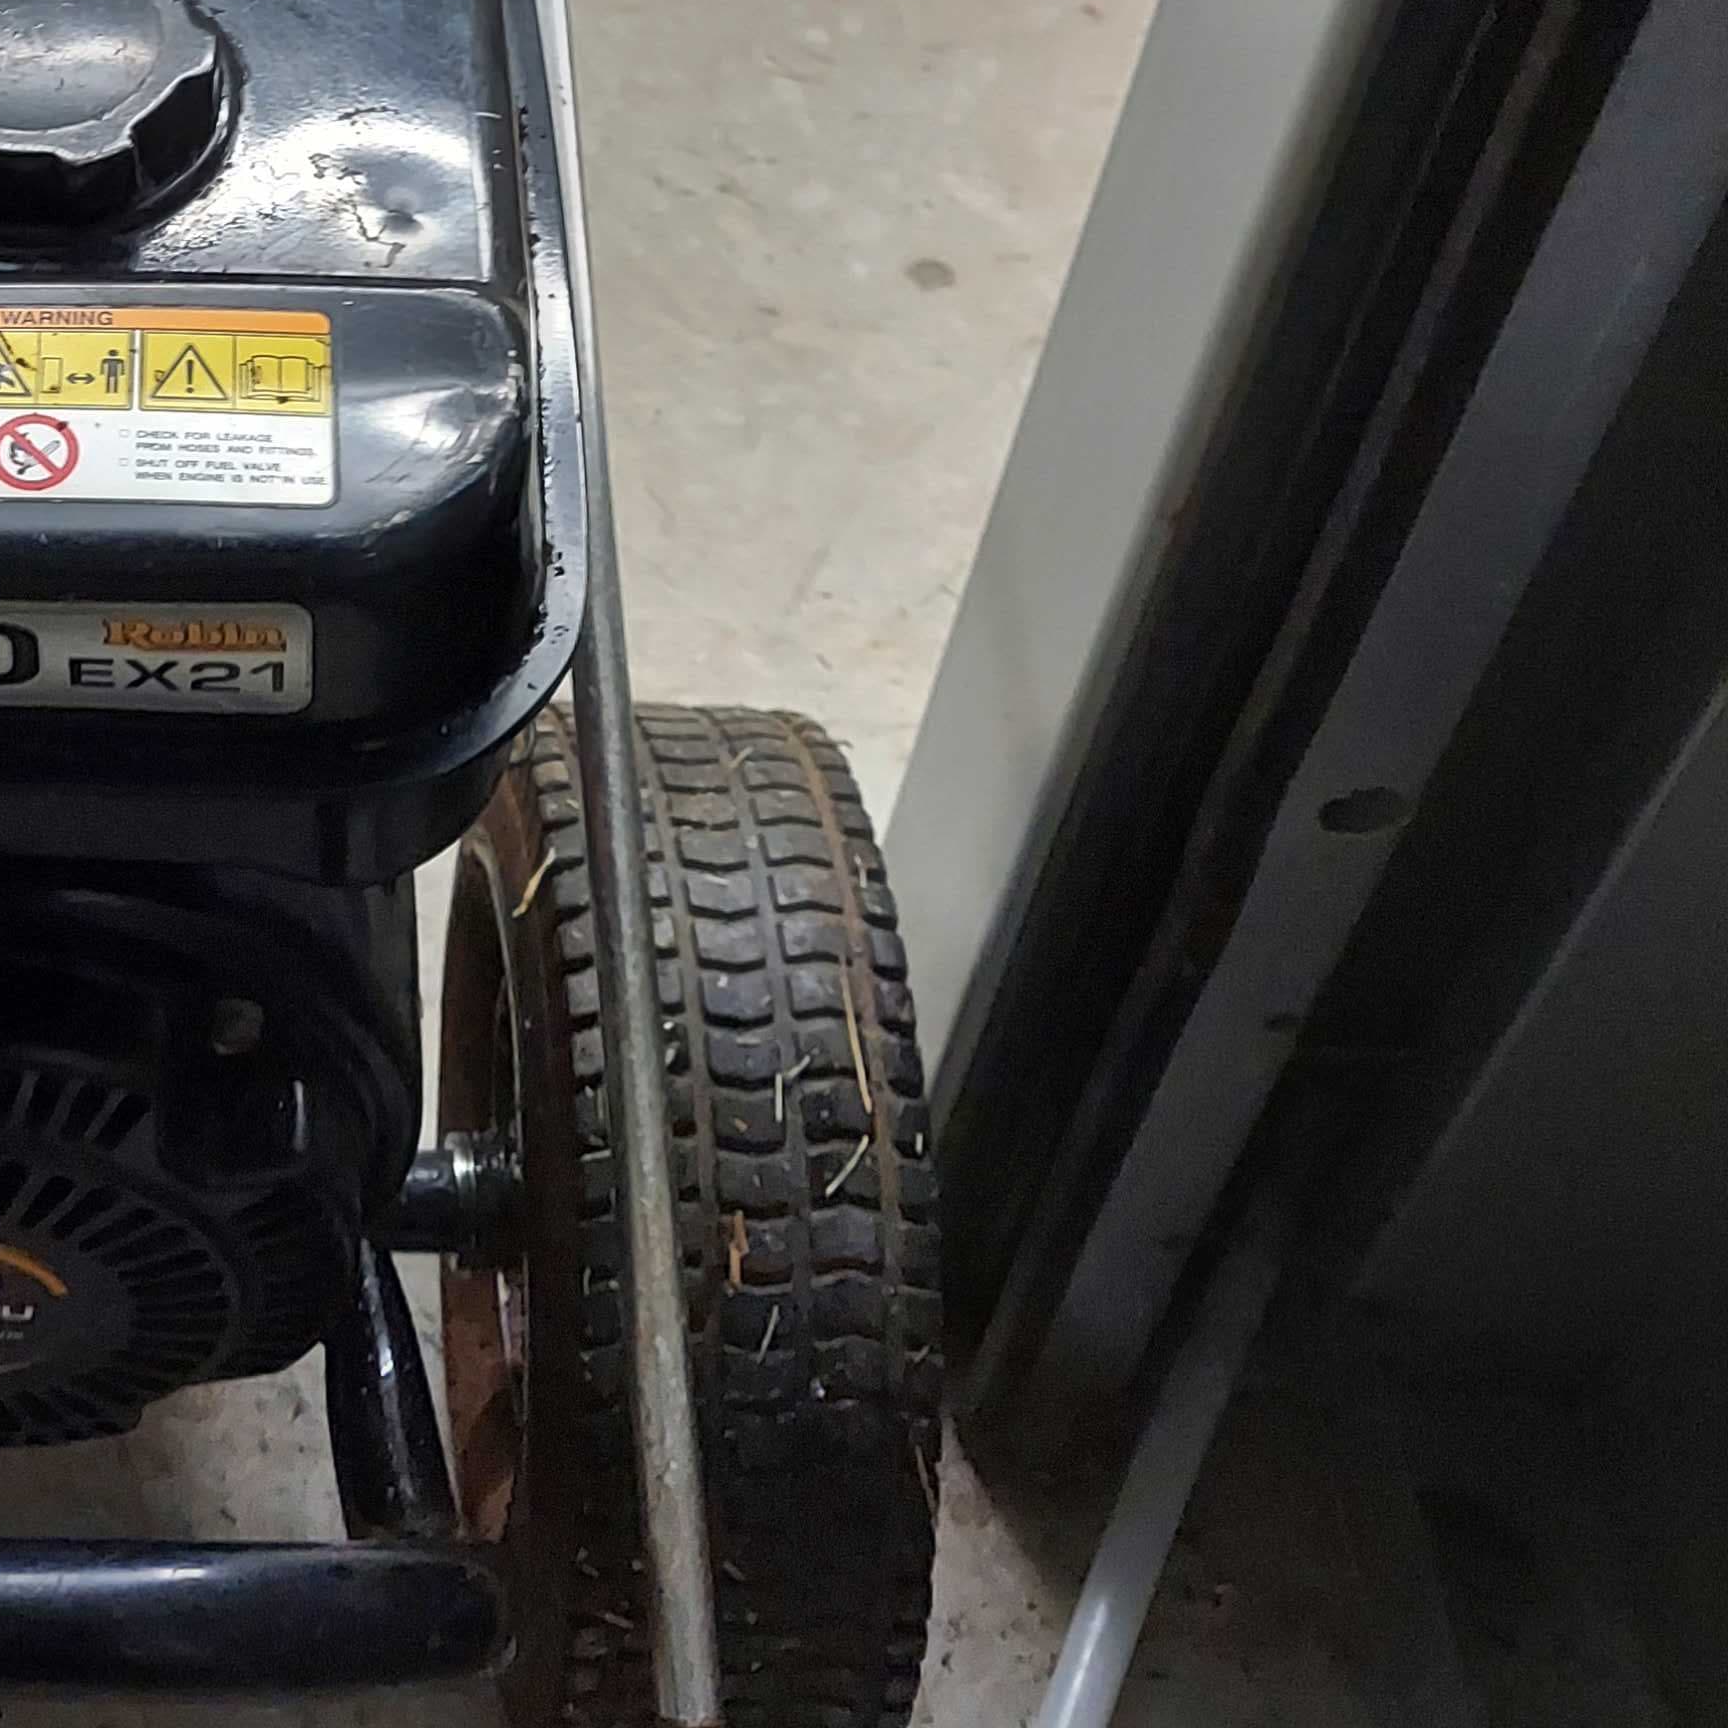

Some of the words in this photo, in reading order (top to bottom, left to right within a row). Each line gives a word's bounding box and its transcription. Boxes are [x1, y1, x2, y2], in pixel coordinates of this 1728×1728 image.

[0, 310, 113, 326] WARNING
[135, 429, 179, 440] CHECK
[184, 431, 211, 441] FOR
[135, 441, 173, 451] FROM
[177, 443, 221, 453] HOSES
[226, 445, 253, 454] AND
[135, 458, 169, 468] SHUT
[175, 459, 199, 469] OFF
[205, 460, 237, 470] FUEL
[135, 471, 173, 481] WHEN
[178, 472, 225, 482] ENGINE
[101, 616, 288, 653] Robin
[68, 657, 286, 694] EX21
